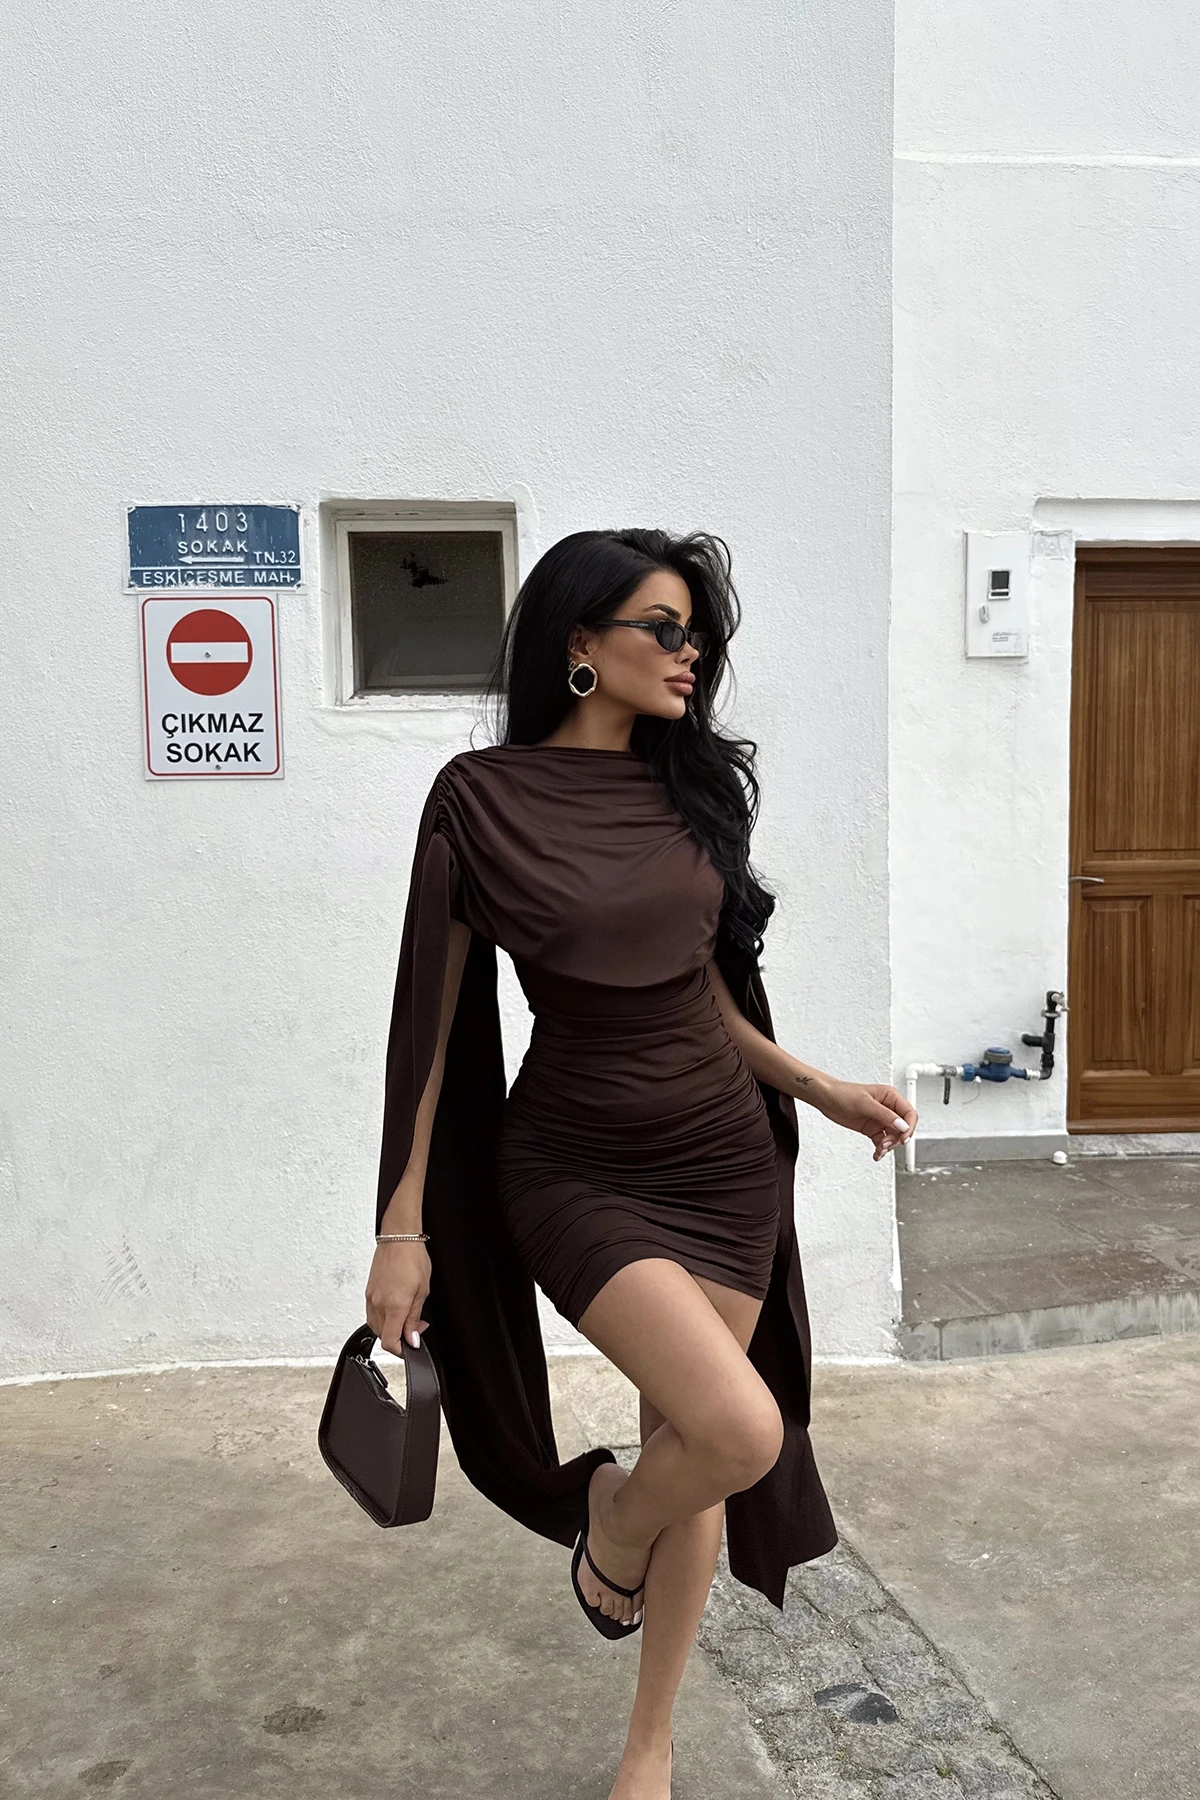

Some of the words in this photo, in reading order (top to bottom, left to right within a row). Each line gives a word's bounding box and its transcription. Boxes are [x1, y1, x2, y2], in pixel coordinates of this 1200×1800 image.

[178, 512, 248, 532] 1403
[178, 540, 248, 554] SOKAK
[253, 552, 296, 564] TN.32
[254, 570, 295, 583] MAH.
[162, 713, 264, 738] ÇIKMAZ
[166, 742, 262, 763] SOKAK
